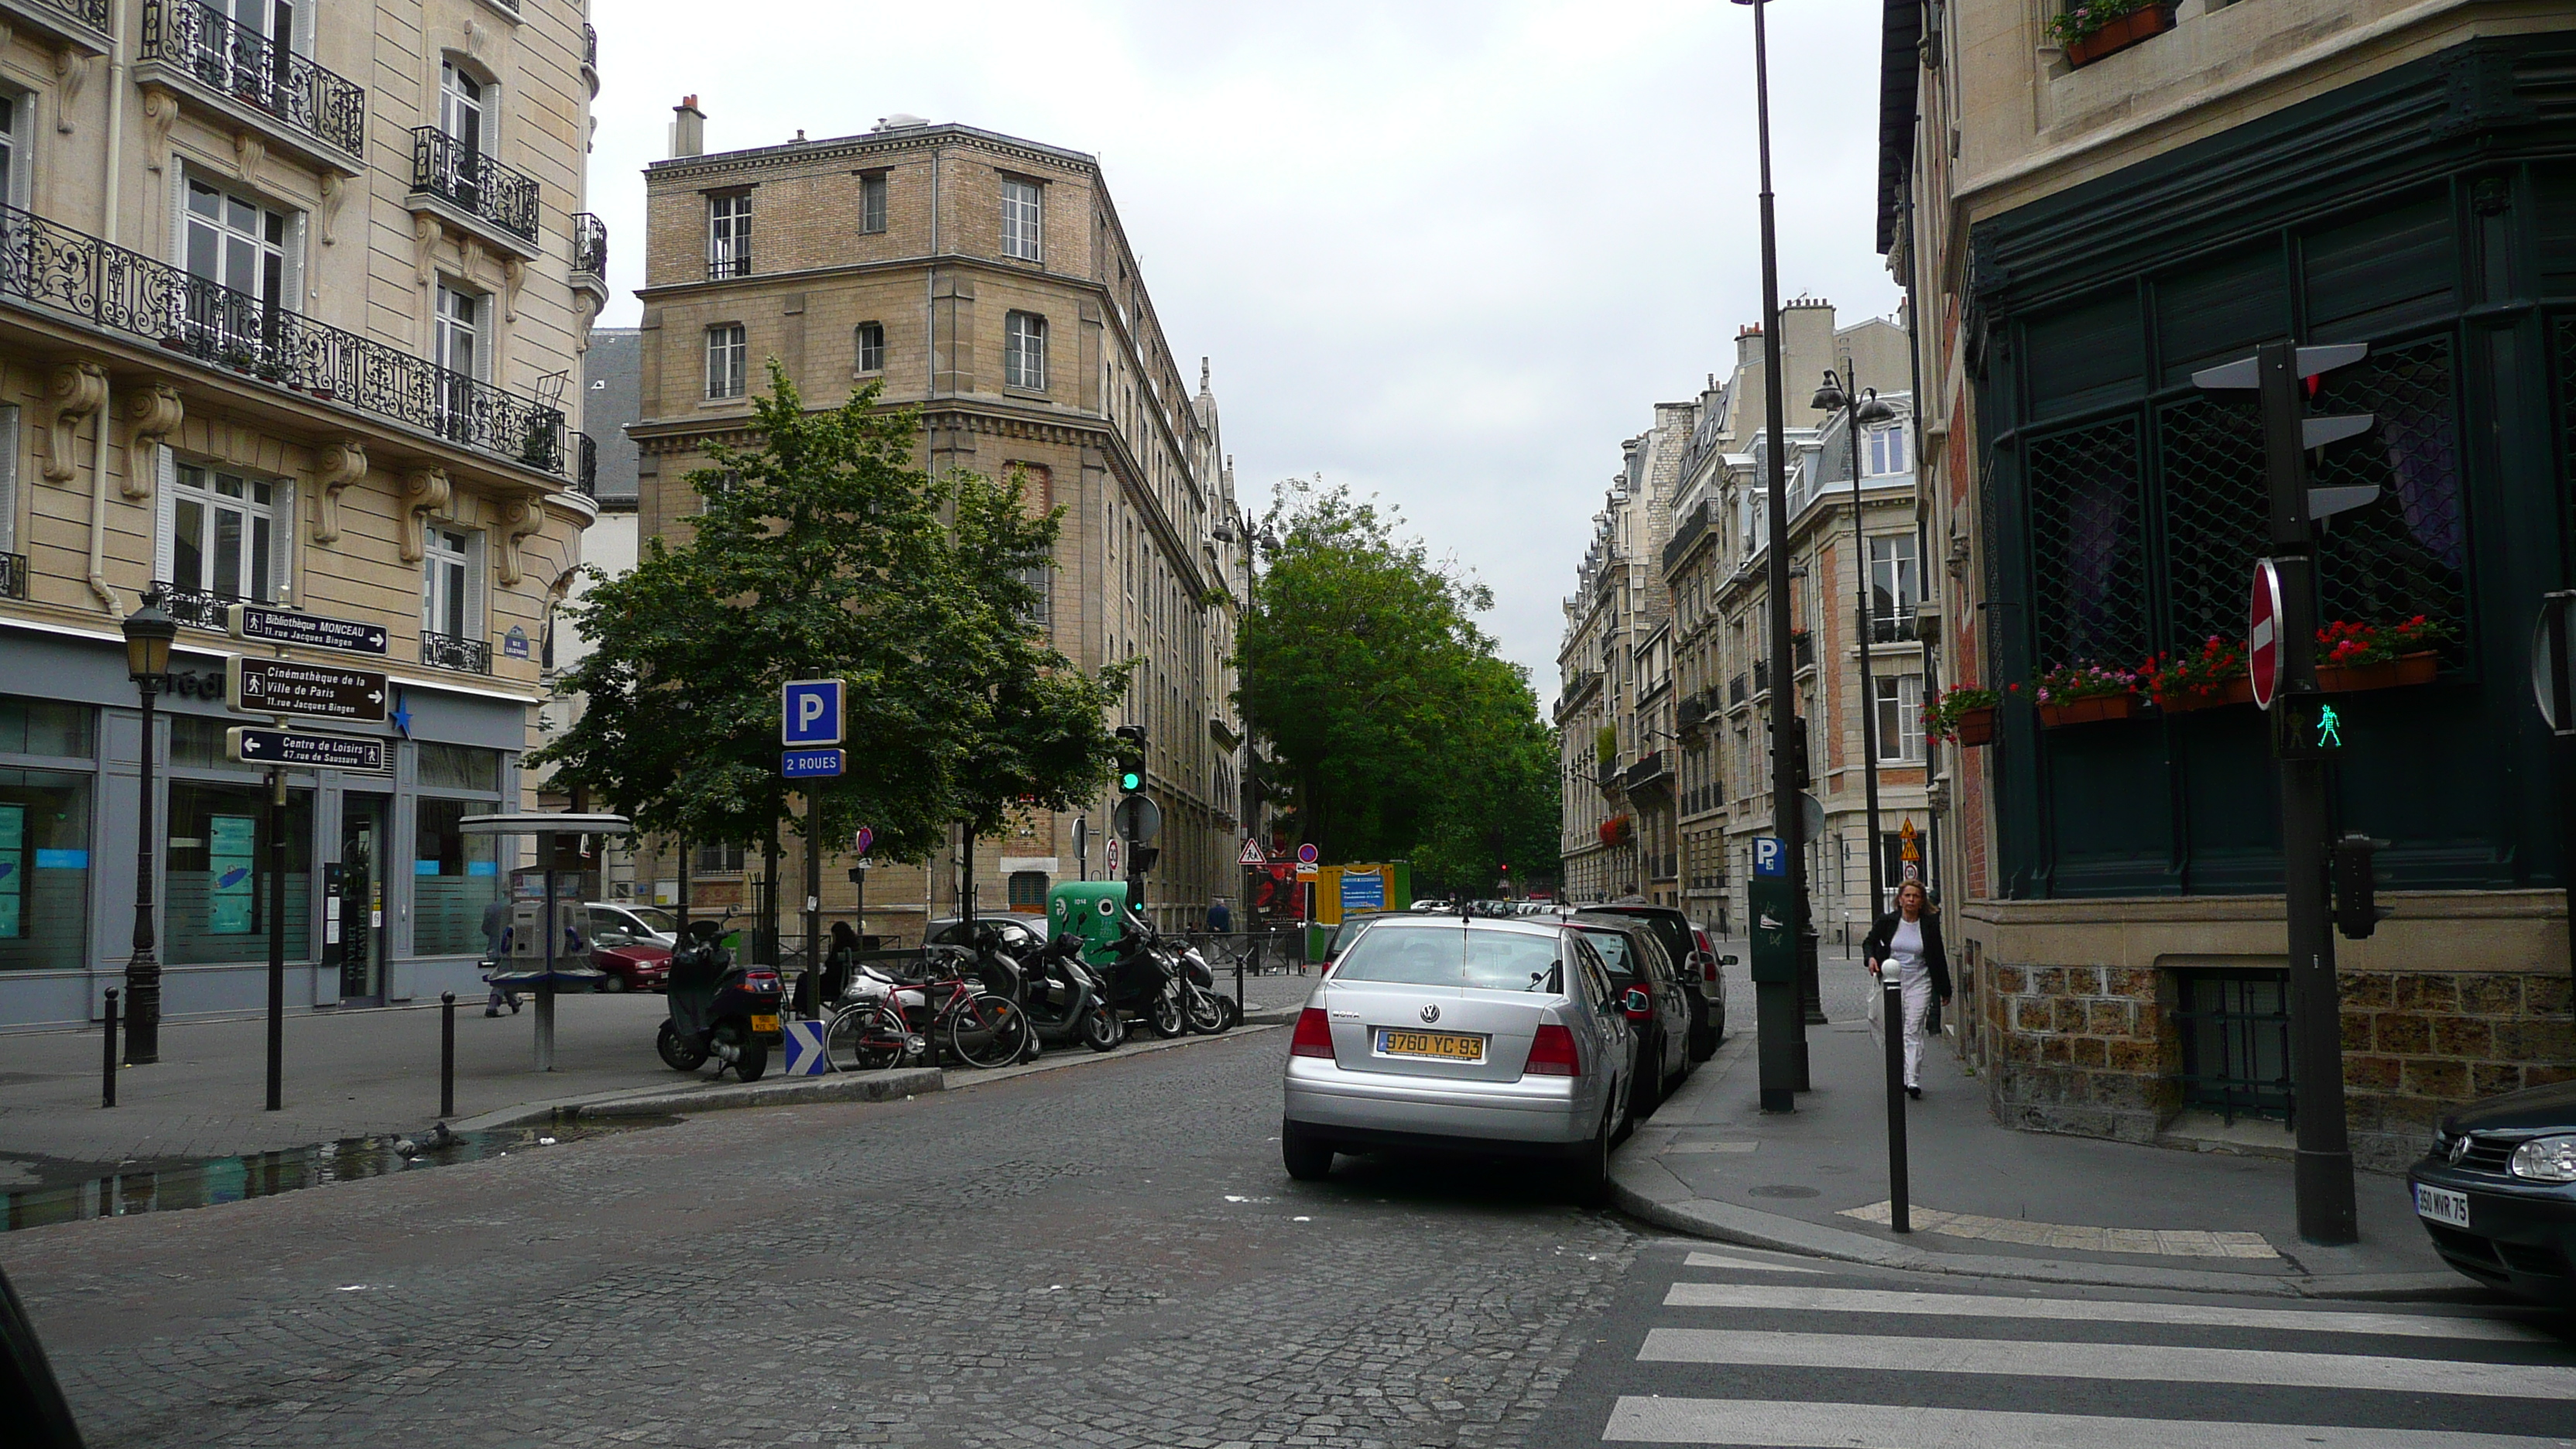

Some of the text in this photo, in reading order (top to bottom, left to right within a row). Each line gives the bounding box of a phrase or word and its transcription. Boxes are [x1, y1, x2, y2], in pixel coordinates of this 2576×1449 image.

[265, 614, 365, 637] Bibliothèque MONCEAU
[290, 631, 324, 643] Jacques
[326, 635, 353, 647] Bingen
[267, 666, 365, 687] Cinémathèque de la
[267, 682, 334, 698] Ville de Paris
[293, 699, 326, 711] Jacques
[328, 703, 355, 714] Bingen
[800, 694, 824, 731] P
[283, 737, 363, 754] Centre de Loisirs
[312, 752, 321, 761] de
[324, 754, 358, 765] Saussure
[786, 757, 836, 770] 2 ROUES
[1758, 840, 1777, 864] P
[1386, 1033, 1427, 1052] 9760
[1434, 1036, 1454, 1053] YC
[1459, 1039, 1480, 1056] 93
[2452, 1197, 2467, 1221] 75
